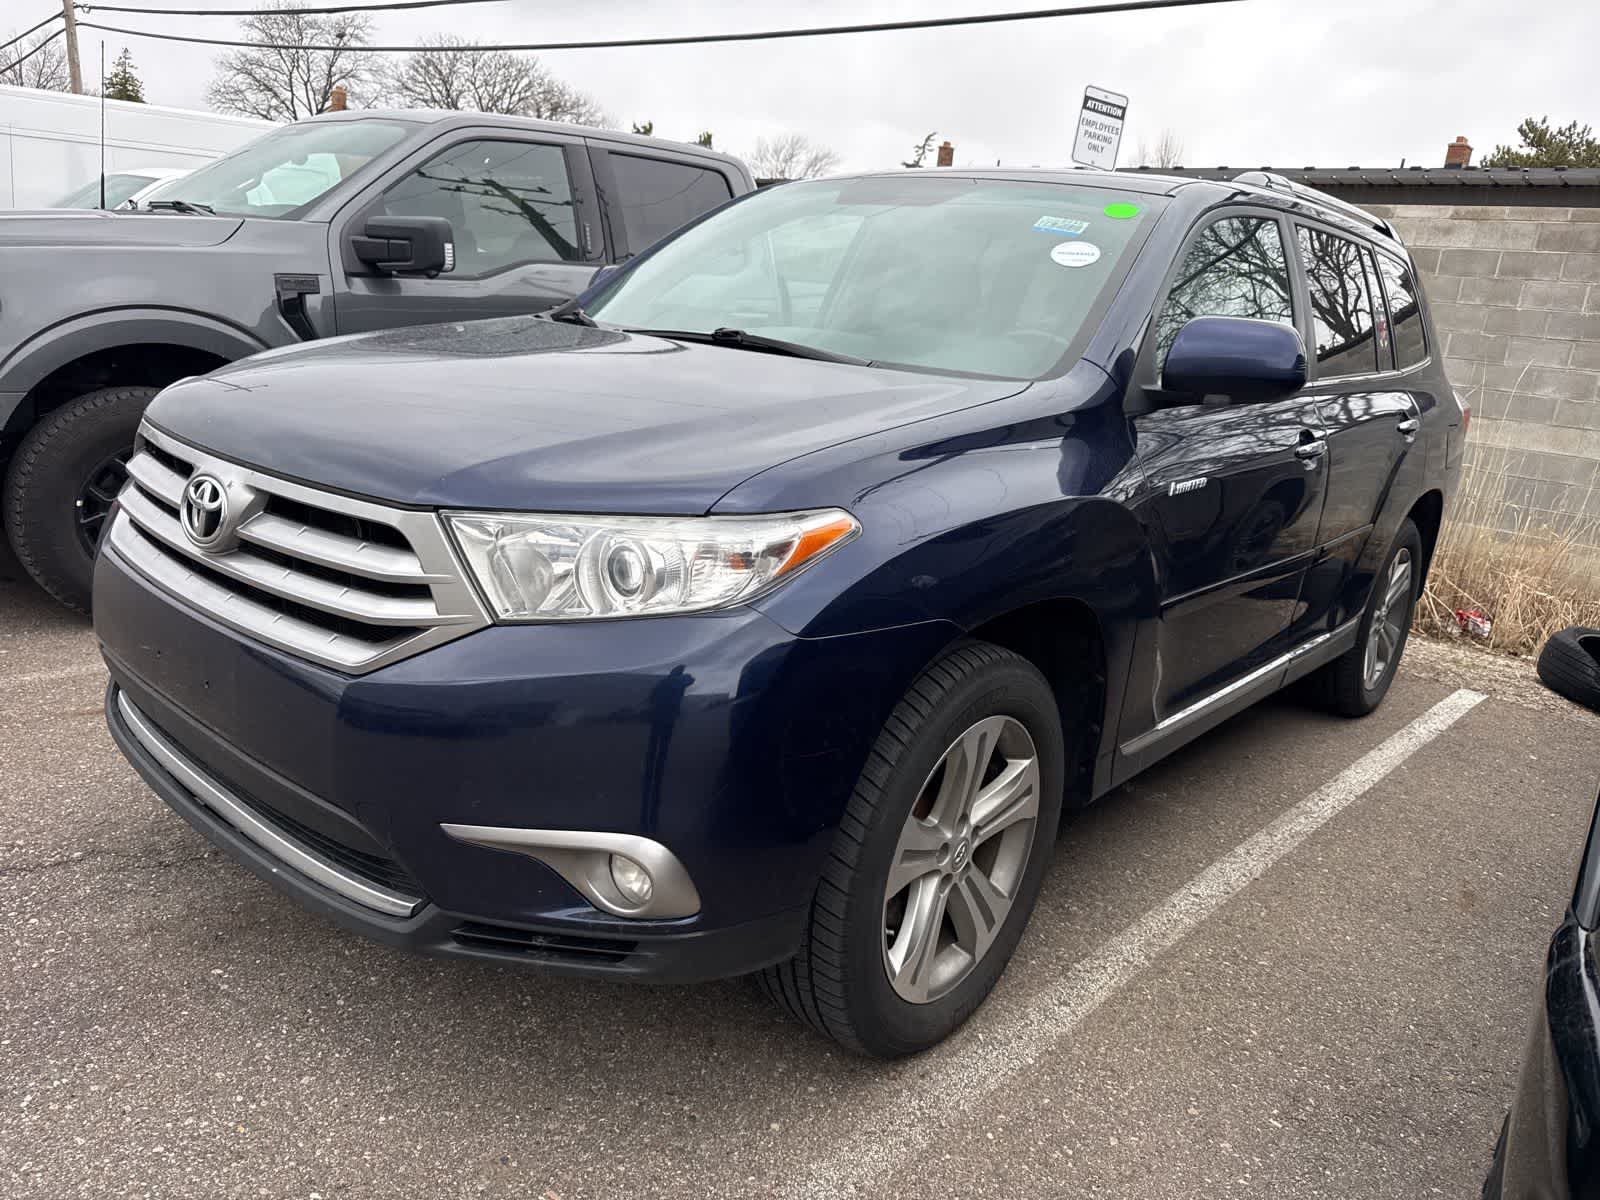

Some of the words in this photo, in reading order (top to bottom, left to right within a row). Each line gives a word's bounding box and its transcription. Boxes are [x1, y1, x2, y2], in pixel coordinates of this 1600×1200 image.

[1086, 99, 1123, 117] ATTENTION
[1081, 117, 1120, 136] EMPLOYEES
[1084, 129, 1112, 144] PARKING
[1088, 142, 1104, 153] ONLY
[1169, 477, 1207, 497] LIMITED
